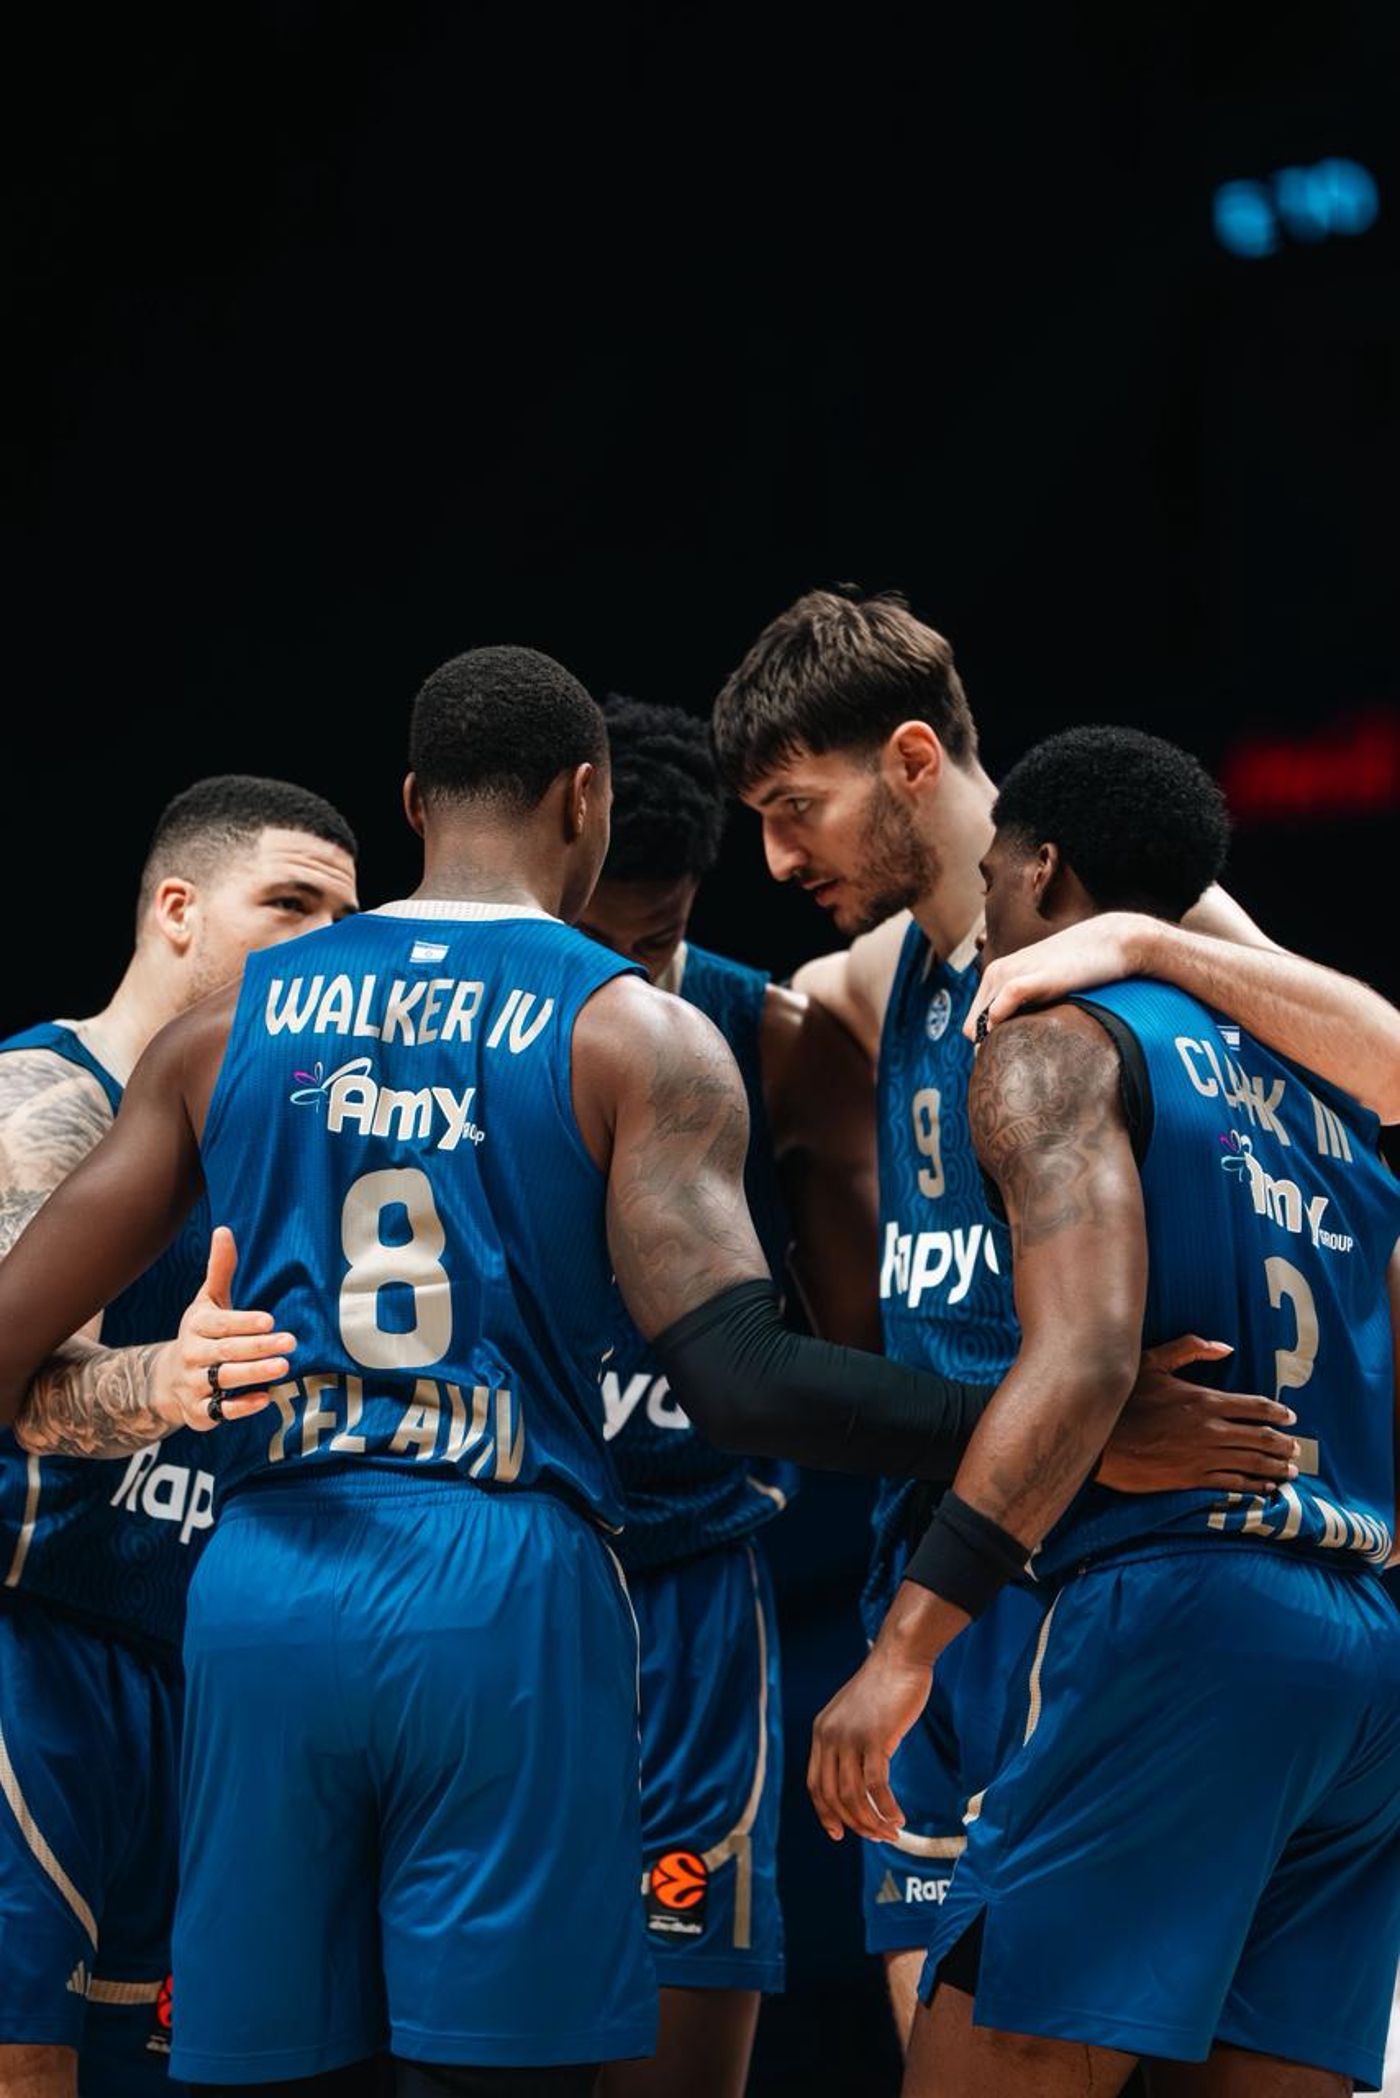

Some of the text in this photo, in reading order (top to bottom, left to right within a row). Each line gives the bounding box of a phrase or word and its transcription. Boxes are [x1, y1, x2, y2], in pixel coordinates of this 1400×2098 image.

[265, 974, 555, 1054] WALKER IV
[327, 1074, 476, 1151] Amy
[912, 1088, 945, 1199] 9
[339, 1167, 453, 1369] 8
